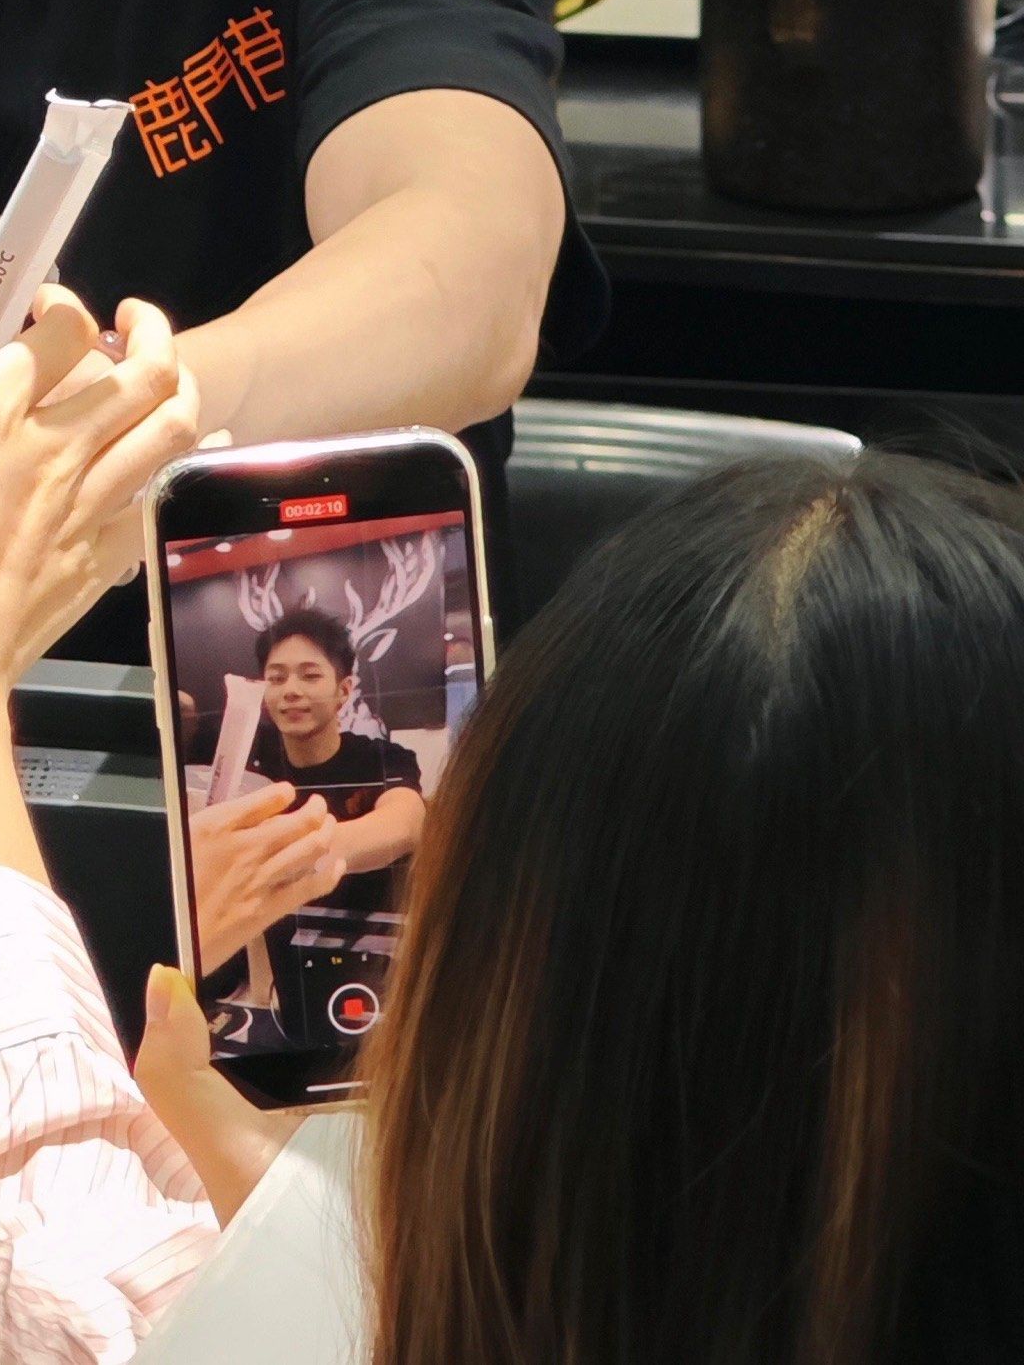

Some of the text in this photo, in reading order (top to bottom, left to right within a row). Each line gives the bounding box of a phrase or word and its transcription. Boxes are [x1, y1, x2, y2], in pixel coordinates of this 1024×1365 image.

[128, 6, 286, 178] 鹿角巷
[284, 500, 344, 518] 00:02:10
